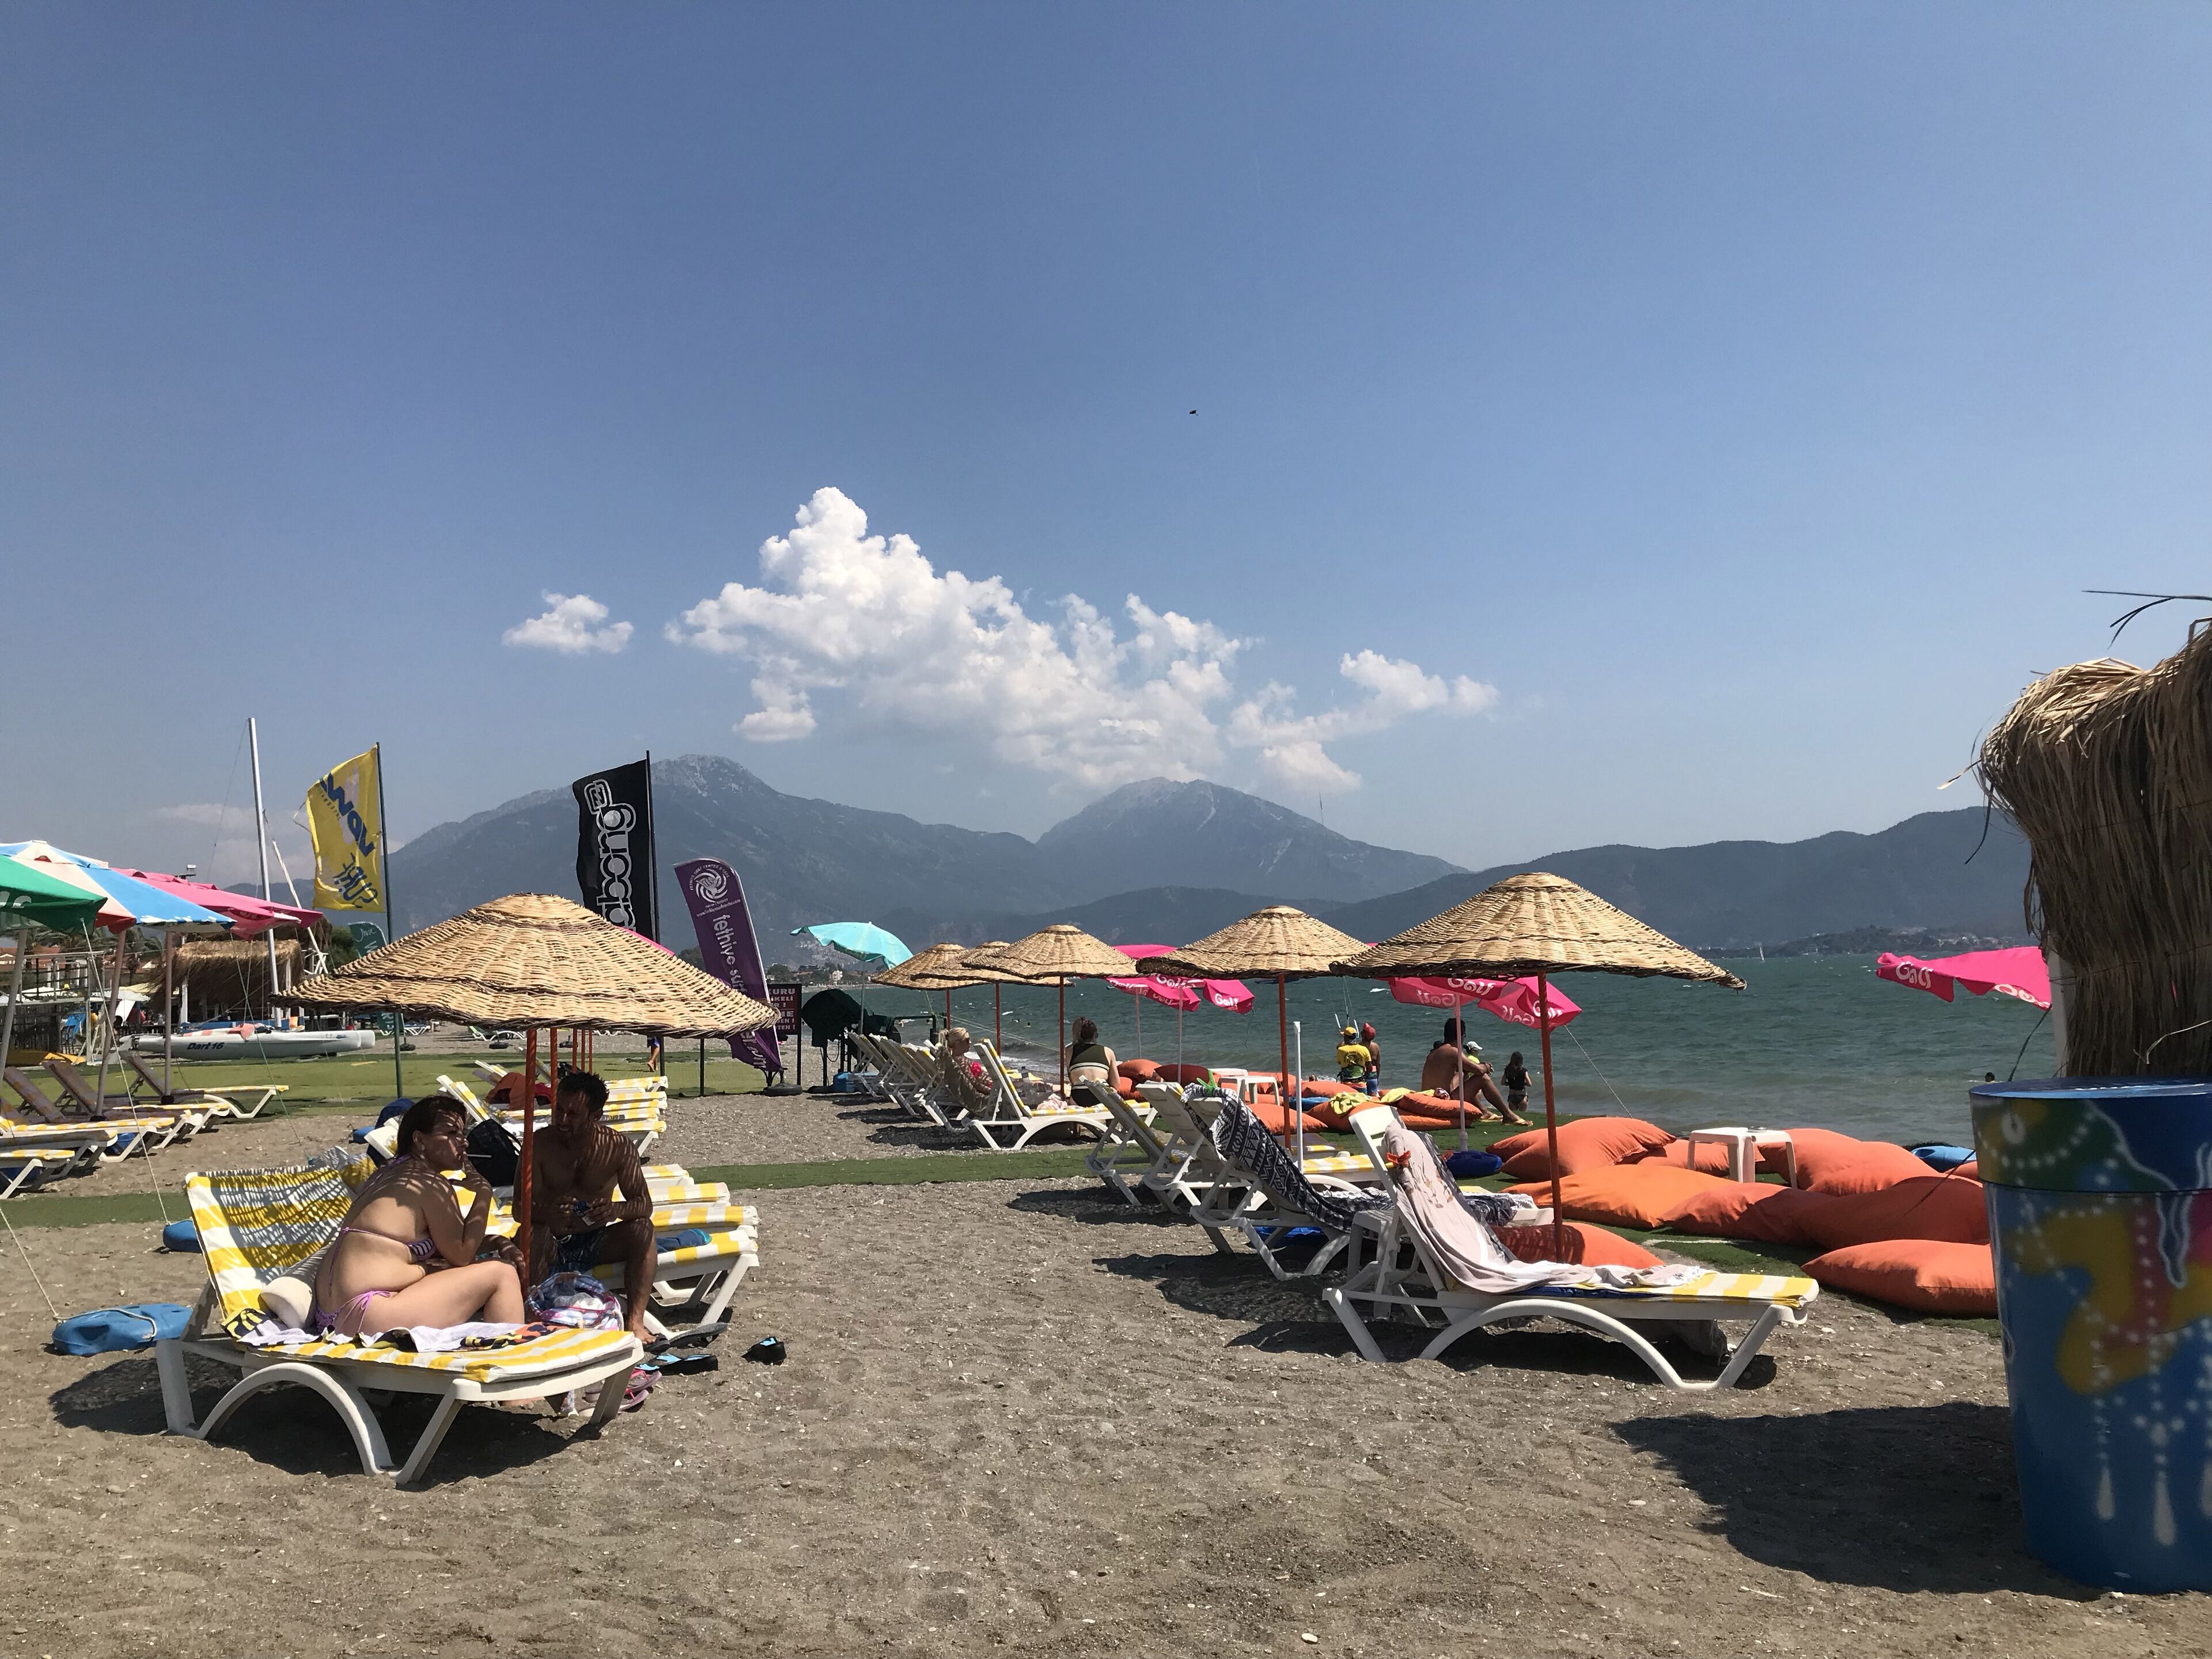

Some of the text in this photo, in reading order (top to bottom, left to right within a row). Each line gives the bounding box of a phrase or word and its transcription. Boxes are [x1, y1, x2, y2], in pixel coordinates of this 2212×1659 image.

[1448, 978, 1496, 995] Golf
[187, 1041, 225, 1050] Dart 16
